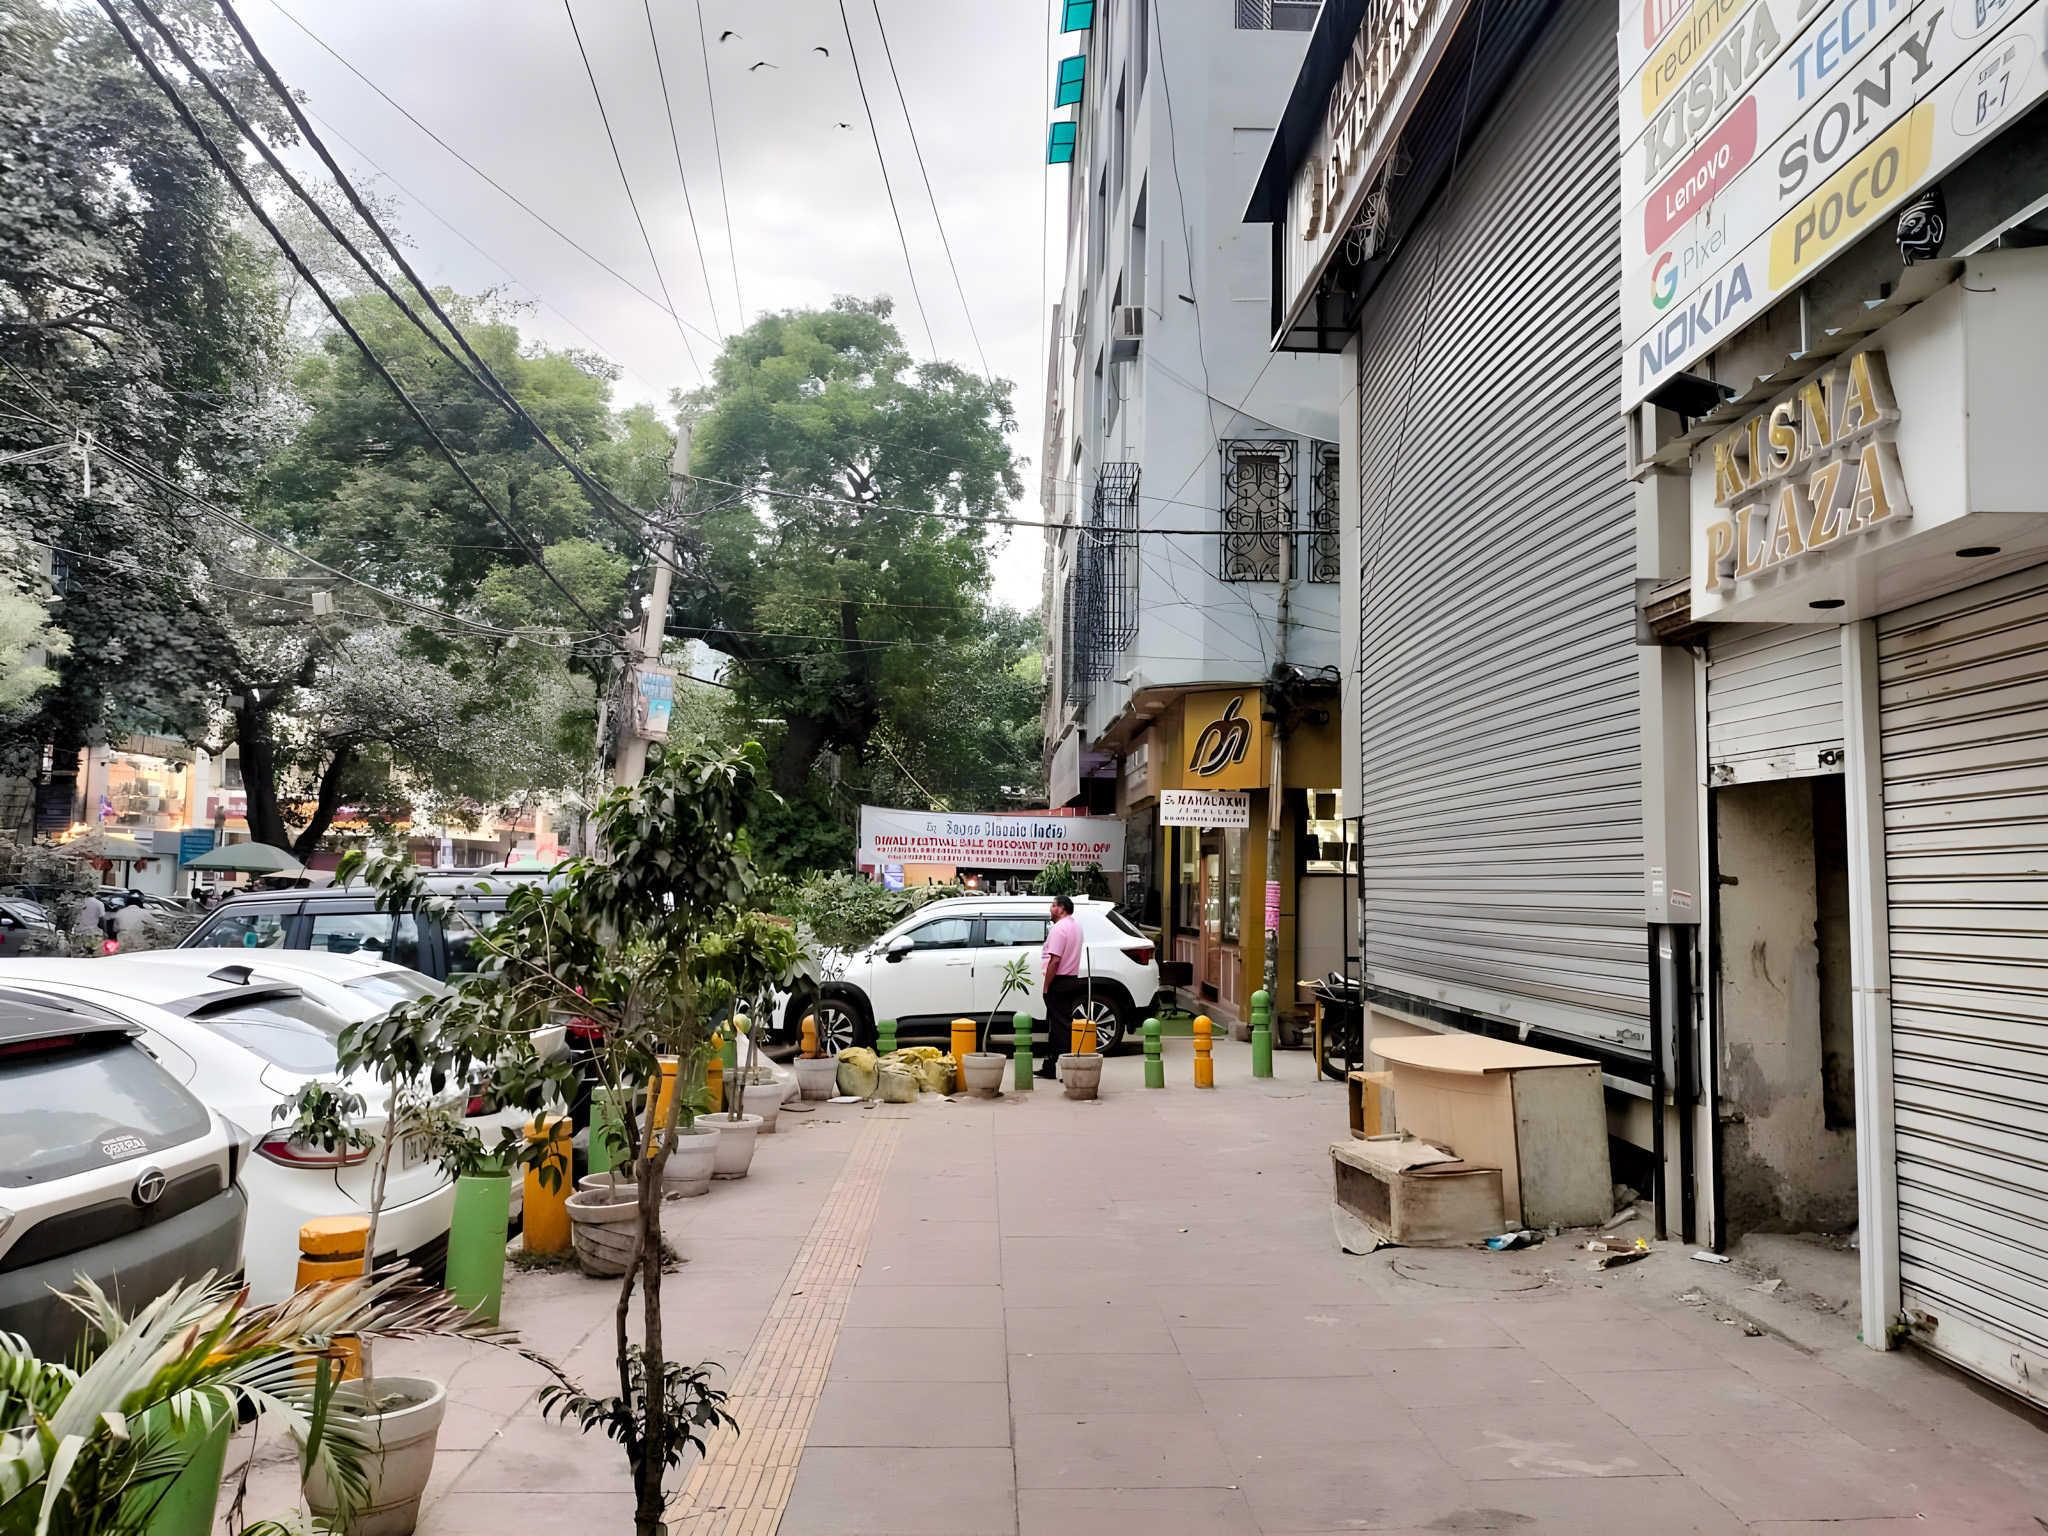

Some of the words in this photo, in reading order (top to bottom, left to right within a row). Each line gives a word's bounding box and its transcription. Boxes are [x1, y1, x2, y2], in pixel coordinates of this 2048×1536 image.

[1644, 3, 1780, 185] KISNA
[1779, 7, 1945, 202] SONY
[1665, 143, 1730, 222] Lenovo
[1793, 146, 1900, 265] POCO
[1683, 213, 1726, 279] Pixel
[1638, 262, 1753, 386] NOKIA
[1712, 350, 1886, 508] KISNA
[1706, 440, 1898, 593] PLAZA
[1177, 795, 1247, 808] MAHALAXMI
